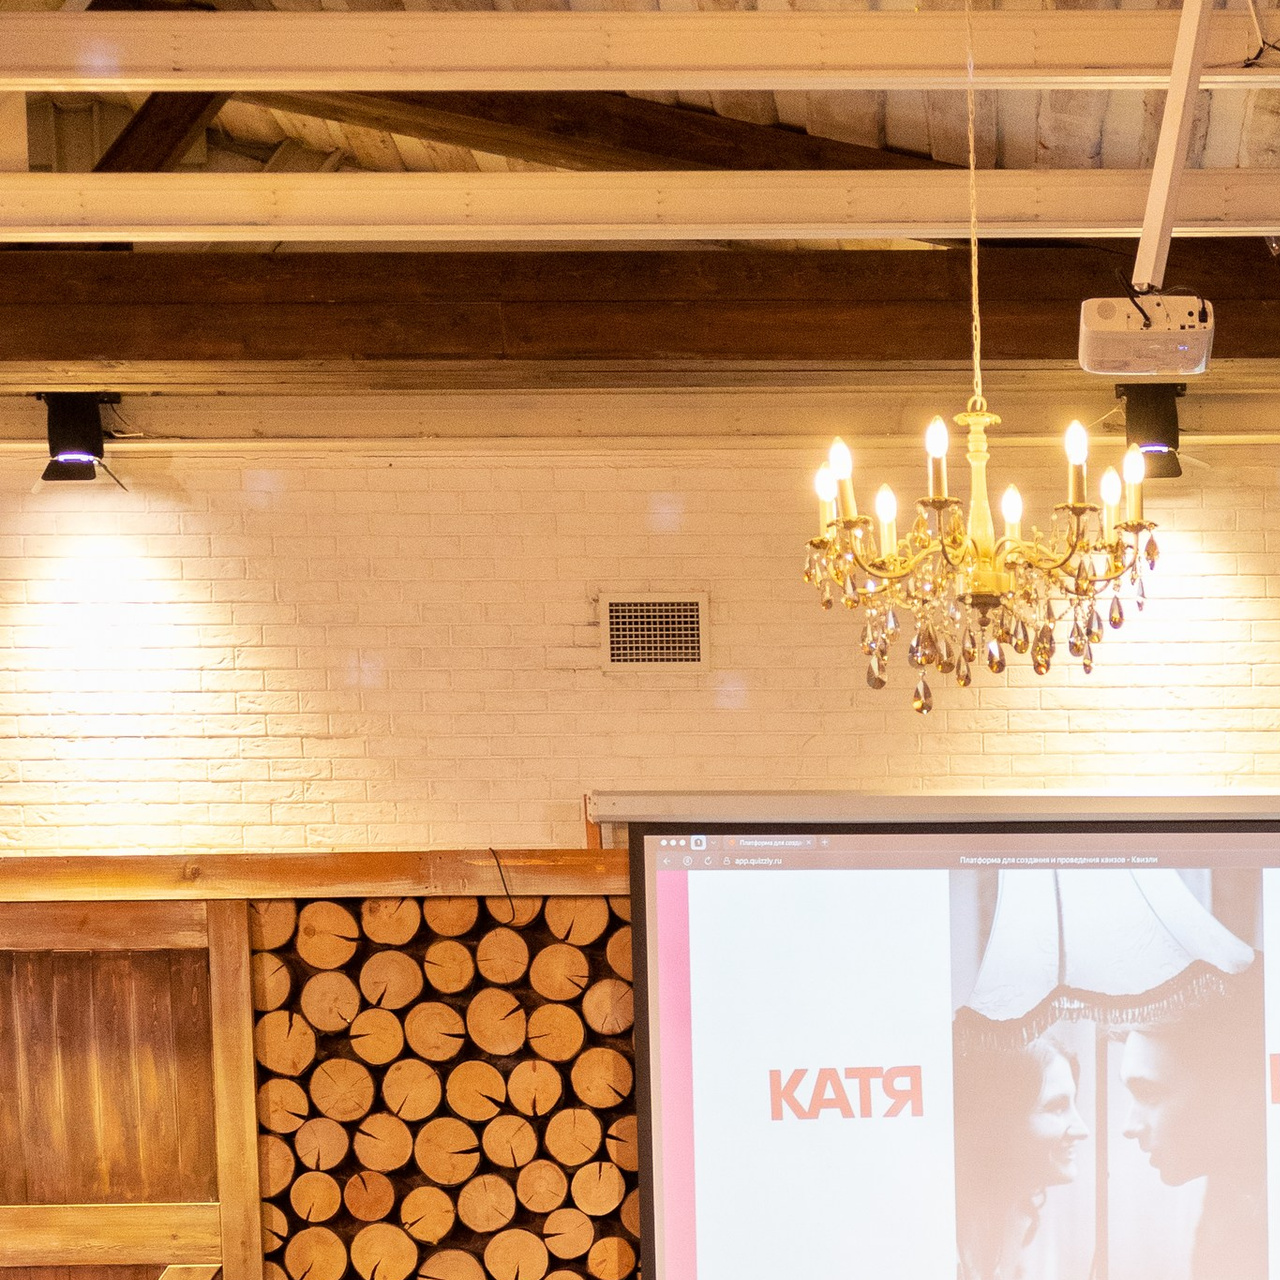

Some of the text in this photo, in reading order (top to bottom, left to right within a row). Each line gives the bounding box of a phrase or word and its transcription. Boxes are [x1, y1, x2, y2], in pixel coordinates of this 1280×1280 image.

[740, 839, 773, 847] Платформа
[735, 857, 782, 865] app.quizzly.ru
[960, 856, 1001, 865] Платформа
[769, 1065, 923, 1120] КАТЯ
